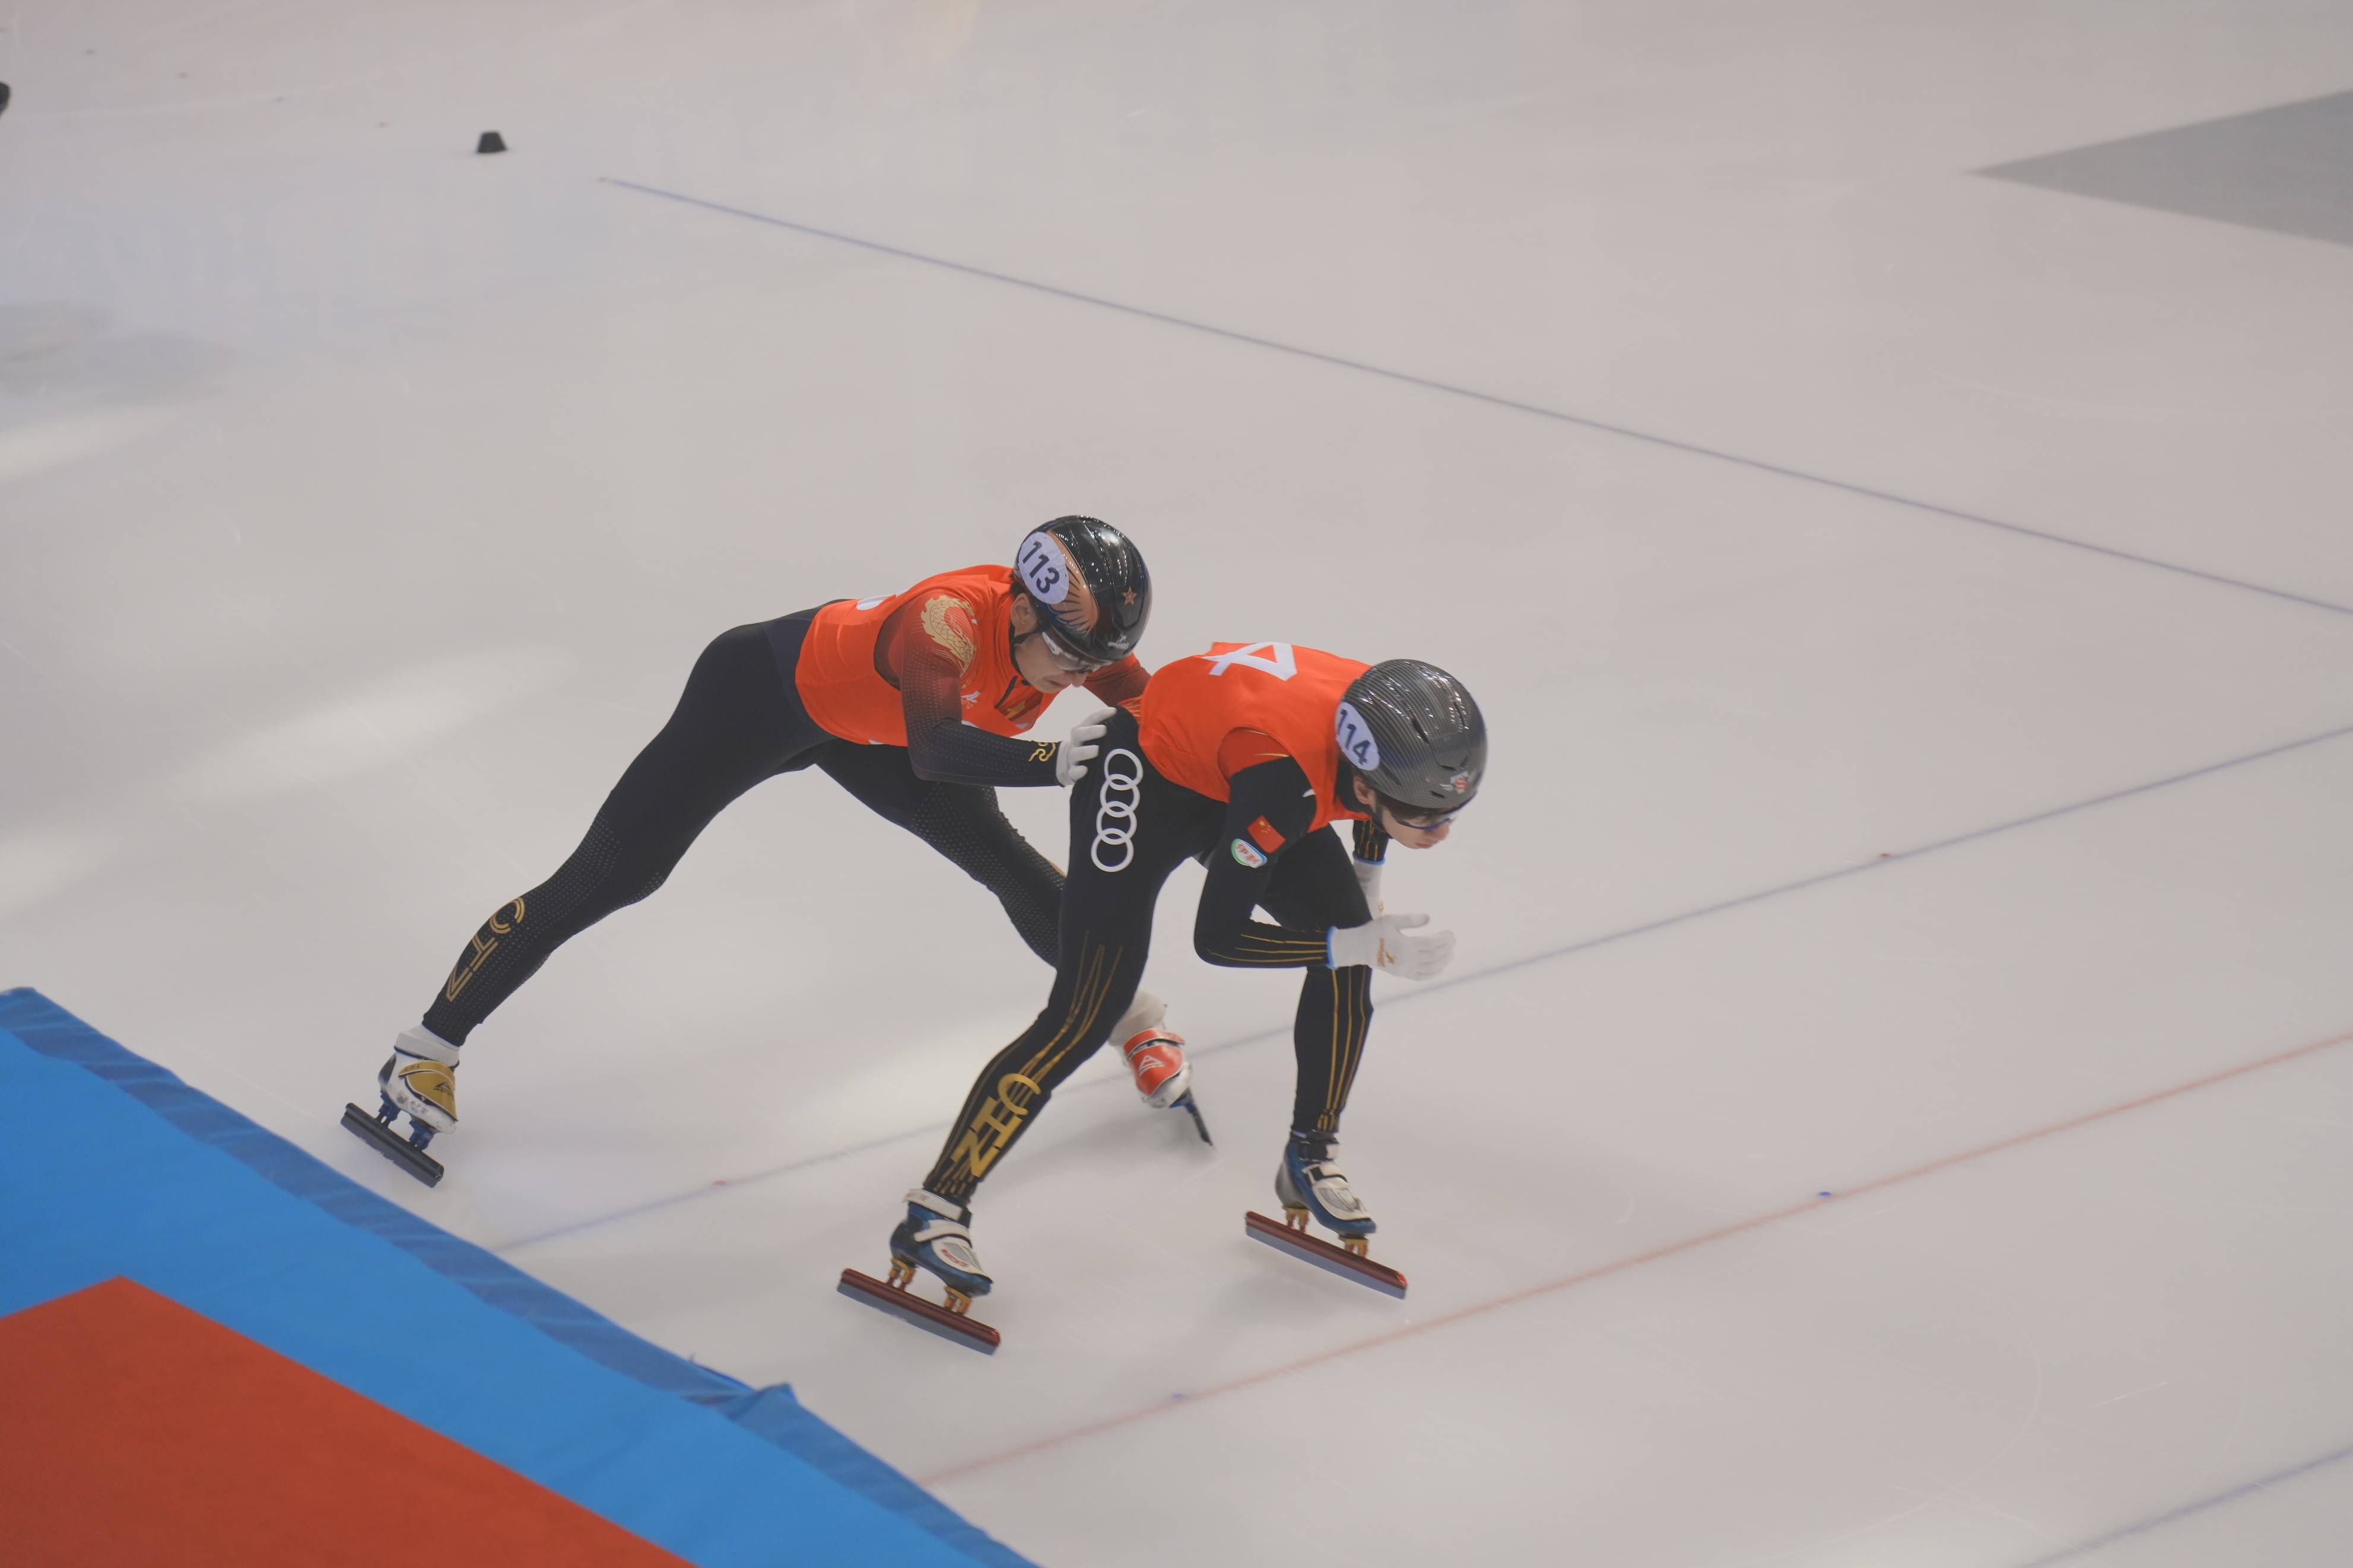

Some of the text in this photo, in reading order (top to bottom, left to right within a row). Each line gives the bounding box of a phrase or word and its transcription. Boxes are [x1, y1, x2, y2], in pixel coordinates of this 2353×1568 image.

[1023, 541, 1059, 593] 113
[1201, 642, 1298, 682] 4
[1338, 709, 1371, 765] 114
[951, 1073, 1041, 1178] CHN
